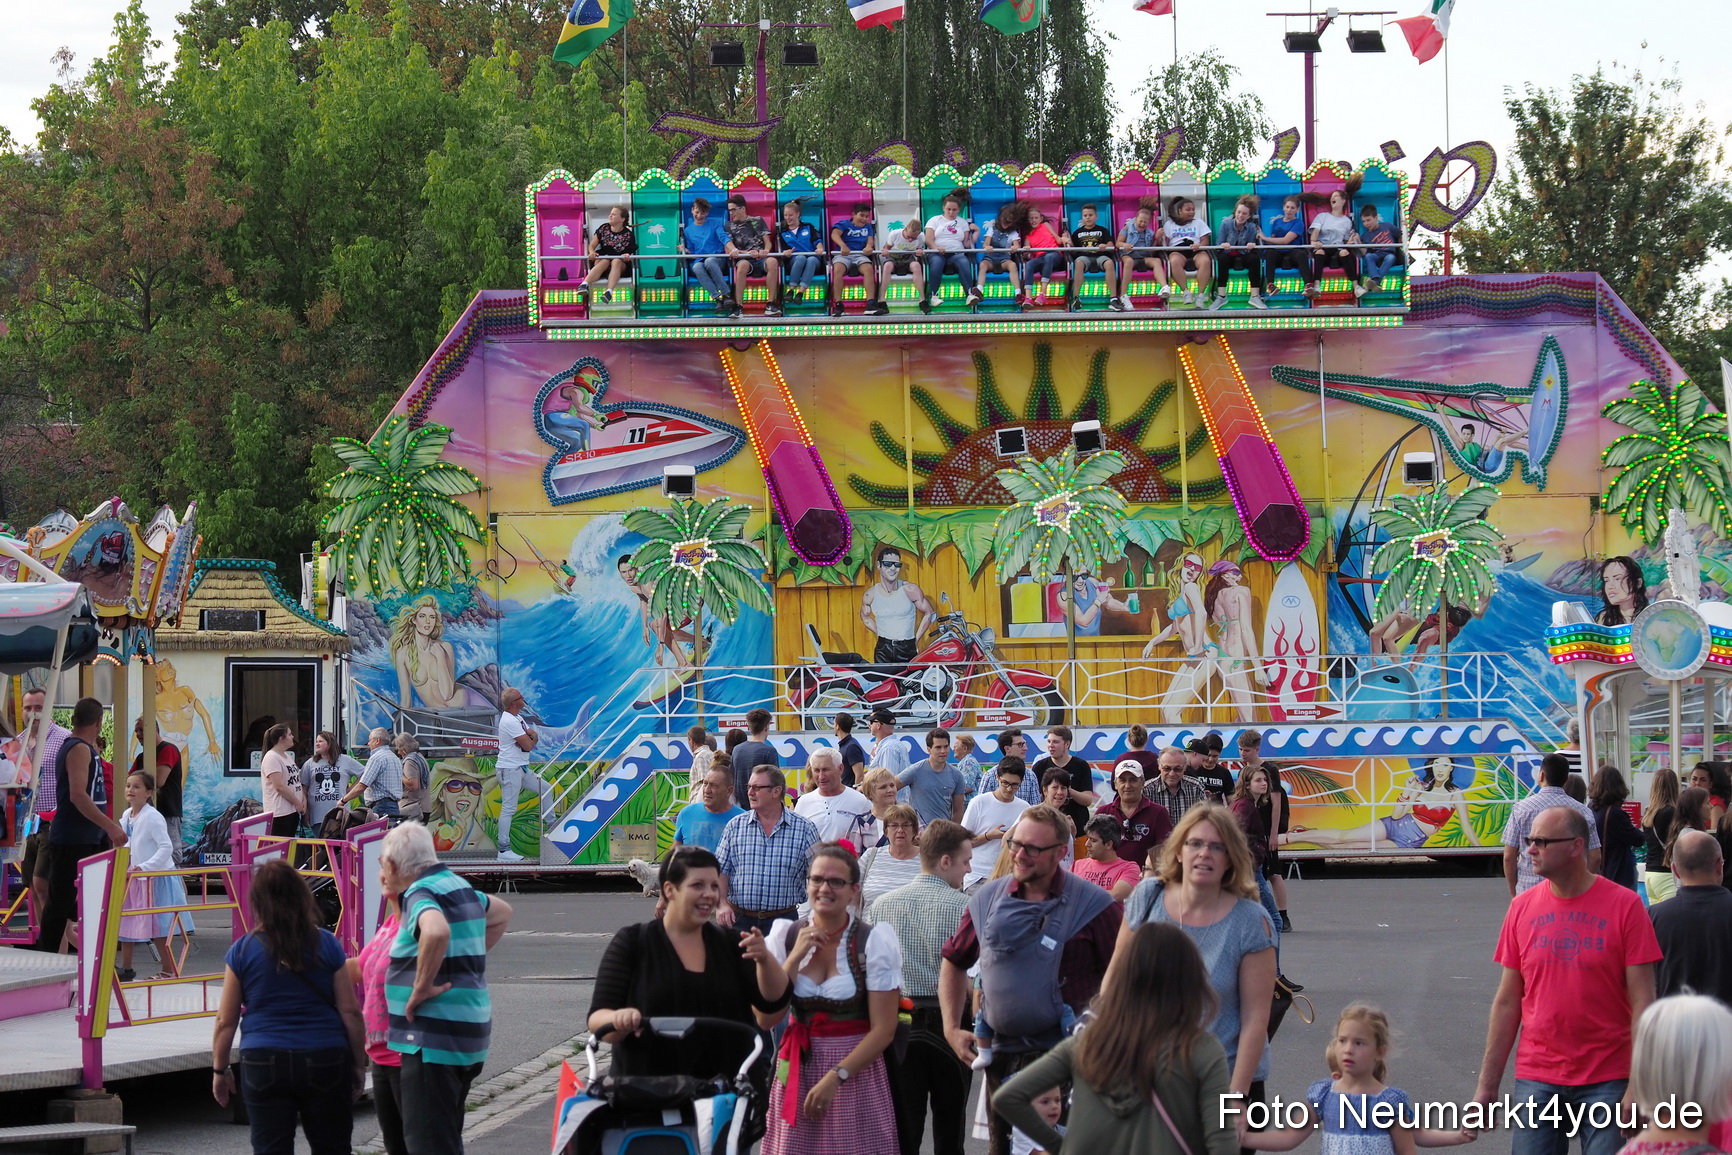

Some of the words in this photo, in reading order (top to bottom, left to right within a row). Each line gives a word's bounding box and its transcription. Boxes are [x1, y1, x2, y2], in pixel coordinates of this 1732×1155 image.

[628, 427, 646, 444] 11
[461, 737, 499, 748] Ausgang
[314, 794, 340, 802] MOUSE
[628, 833, 650, 841] KMG
[205, 854, 211, 862] M
[215, 854, 227, 862] KA
[1530, 911, 1556, 929] TOM
[1560, 911, 1608, 930] TAILOR
